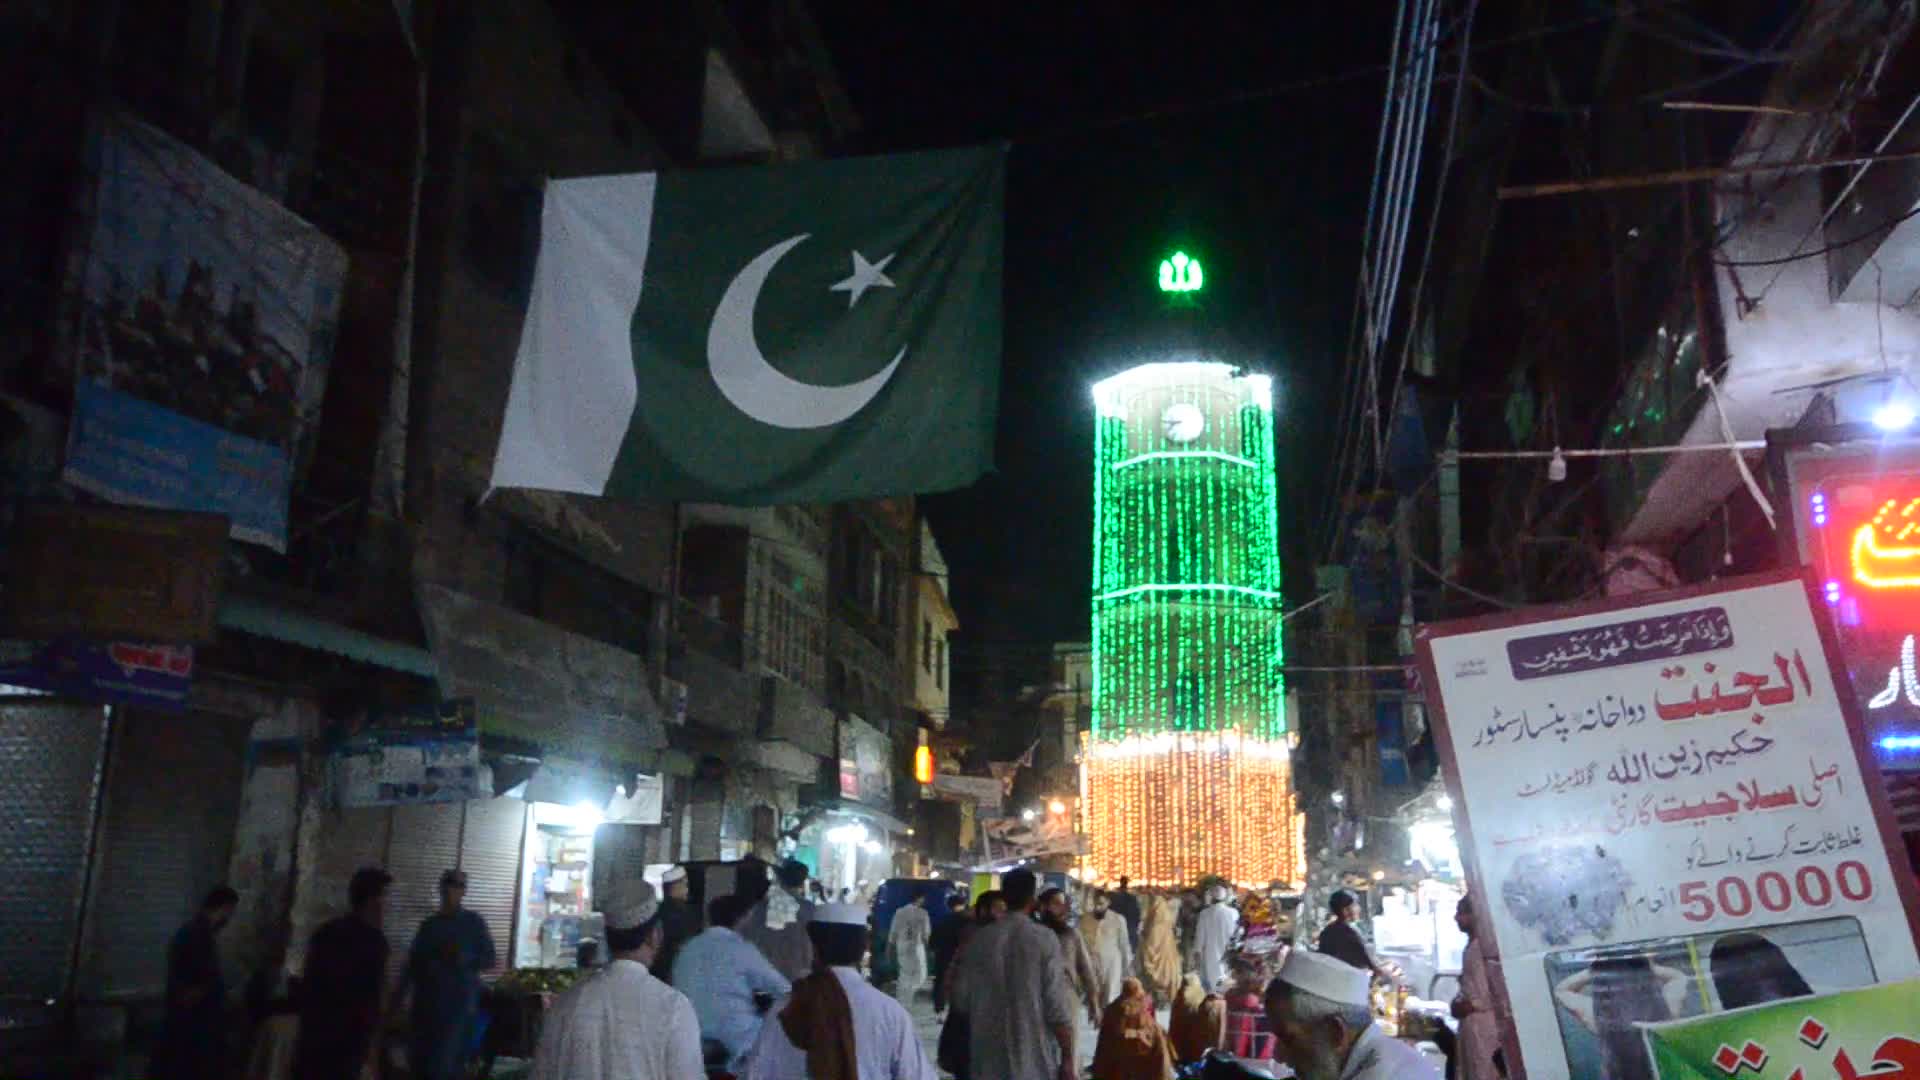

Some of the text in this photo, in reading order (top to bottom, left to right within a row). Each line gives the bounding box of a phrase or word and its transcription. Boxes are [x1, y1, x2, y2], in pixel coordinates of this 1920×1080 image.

[1654, 648, 1813, 725] الجنت
[1650, 738, 1703, 780] زین
[1705, 728, 1774, 775] حکیم
[1653, 778, 1800, 828] سلاجیت
[1800, 755, 1843, 809] اصلی
[1679, 860, 1873, 923] 50000
